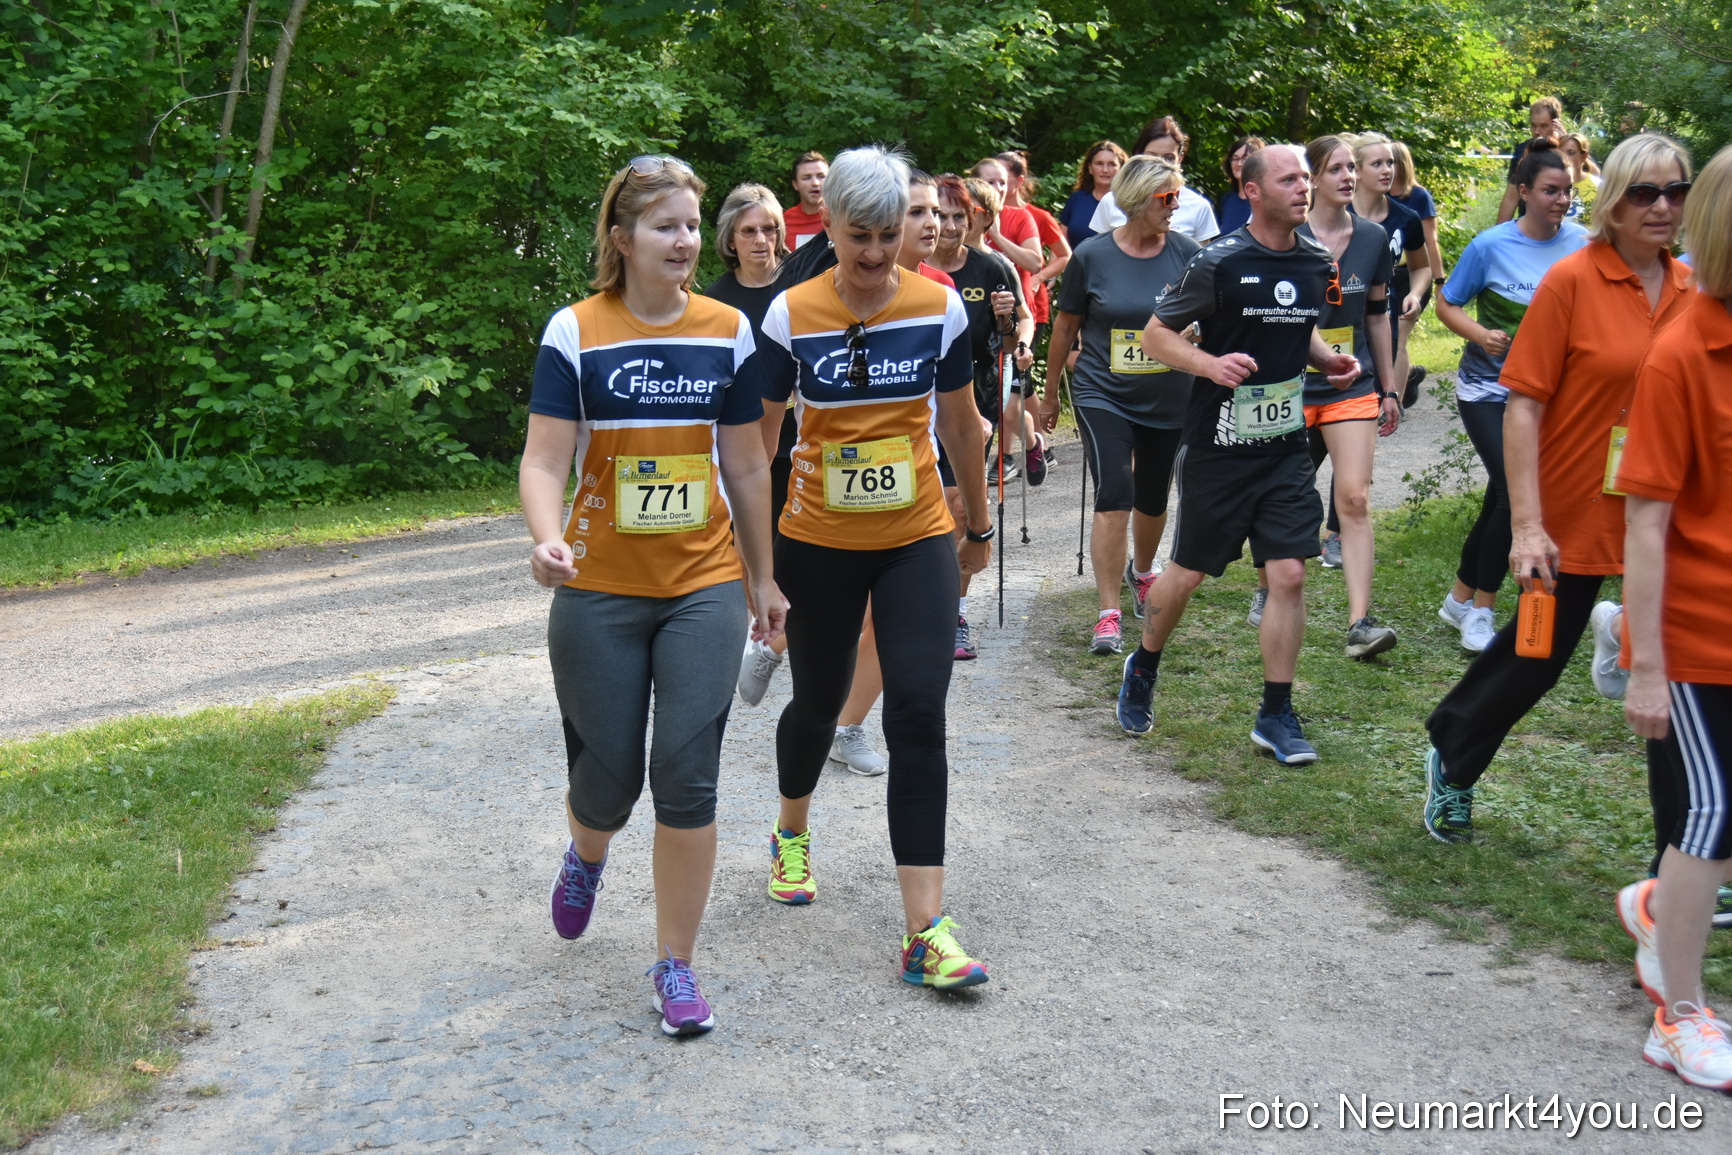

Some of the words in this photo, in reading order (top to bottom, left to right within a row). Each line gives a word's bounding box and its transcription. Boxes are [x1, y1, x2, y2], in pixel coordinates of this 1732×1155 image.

[1240, 276, 1260, 284] JAKO
[1506, 282, 1538, 292] RAIL
[1262, 316, 1307, 324] SCHOTTERWERKE
[1123, 345, 1155, 362] 41
[629, 374, 718, 394] Fischer
[841, 374, 918, 388] AUOMOBILE
[638, 395, 712, 405] AUTOMOBILE
[1252, 399, 1292, 423] 105
[630, 470, 672, 481] firmenlauf
[841, 465, 896, 493] 768
[637, 483, 688, 512] 771
[870, 490, 898, 500] Schmid
[637, 513, 668, 521] Melanie
[669, 512, 692, 520] Dorner
